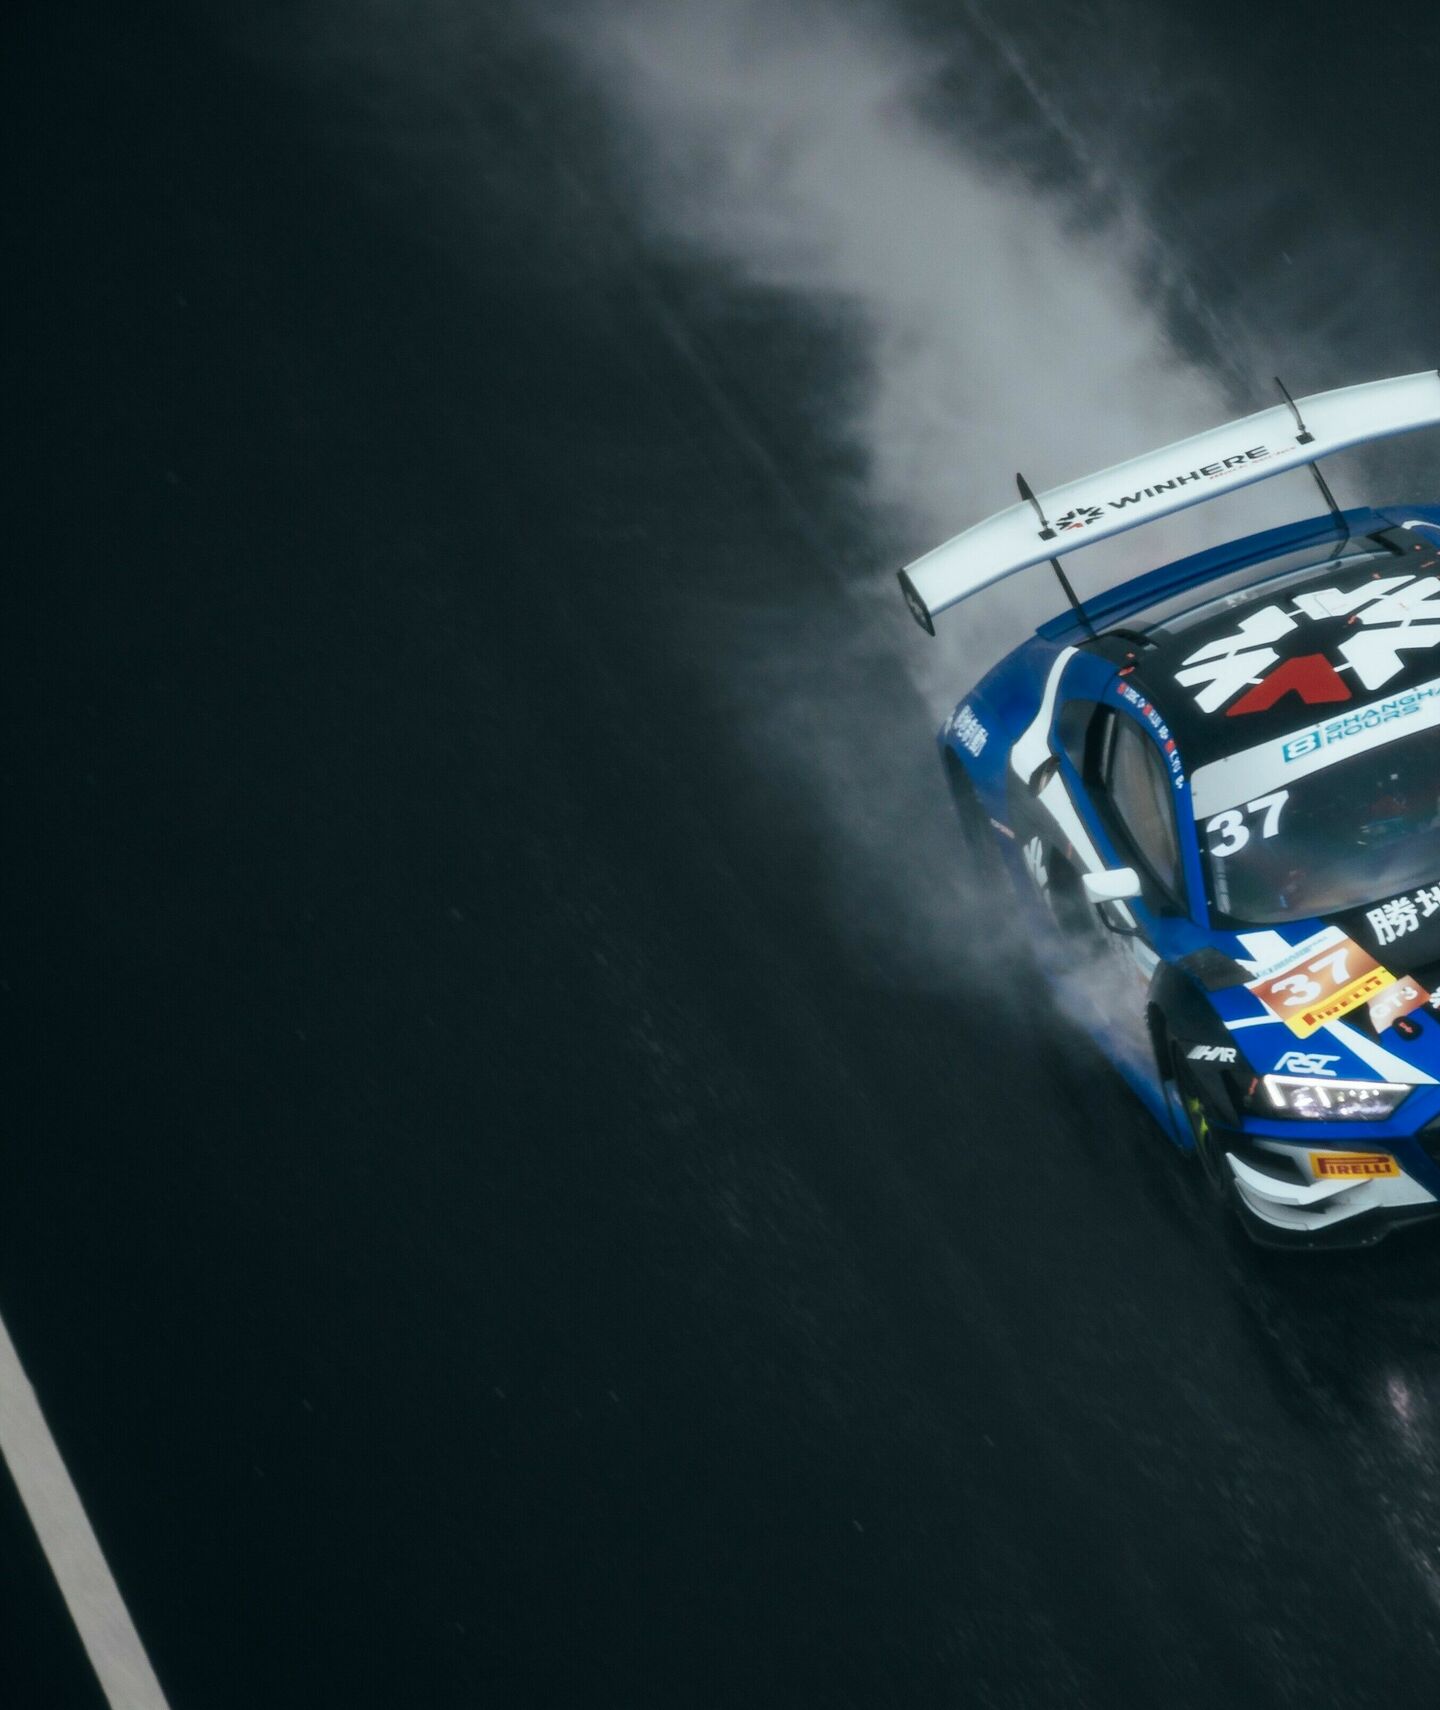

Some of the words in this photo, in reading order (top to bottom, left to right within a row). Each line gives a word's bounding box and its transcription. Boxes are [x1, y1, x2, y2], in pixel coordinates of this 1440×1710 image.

[1108, 446, 1269, 509] WINHERE
[1286, 732, 1321, 761] 8
[1327, 703, 1421, 744] HOURS
[1206, 790, 1289, 857] 37
[1270, 947, 1351, 1007] 37
[1317, 1156, 1392, 1175] PIRELLI
